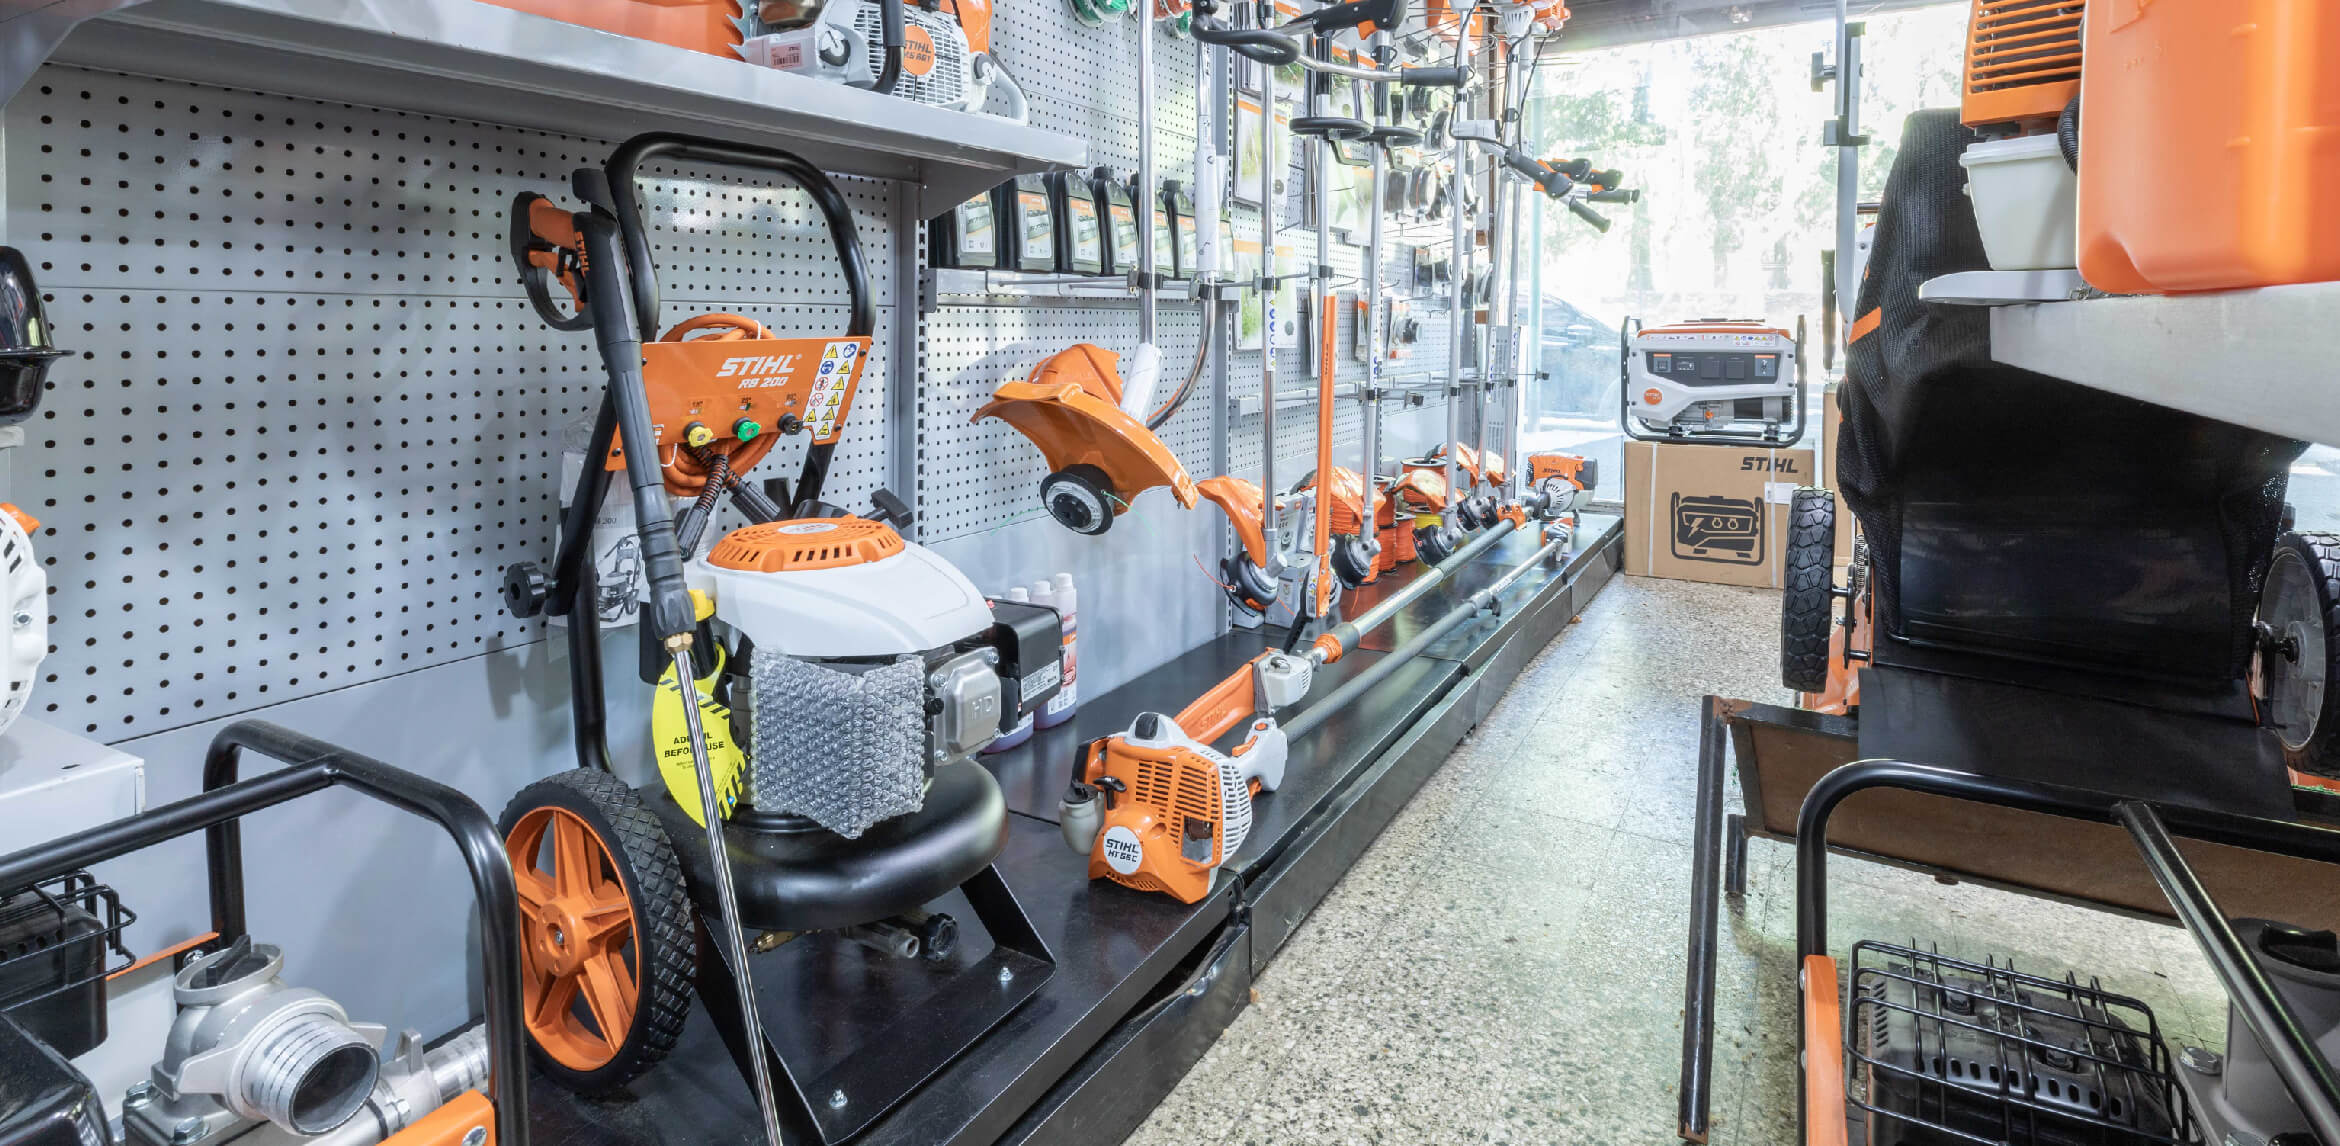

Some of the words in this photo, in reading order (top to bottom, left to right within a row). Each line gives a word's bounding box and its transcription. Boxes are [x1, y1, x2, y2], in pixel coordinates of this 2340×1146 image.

[575, 231, 590, 279] STIHL
[715, 354, 795, 378] STIHL
[760, 376, 789, 388] 200
[1740, 456, 1799, 474] STIHL
[664, 746, 693, 758] BEFO
[1106, 838, 1140, 854] STIHL
[1107, 849, 1120, 858] HT
